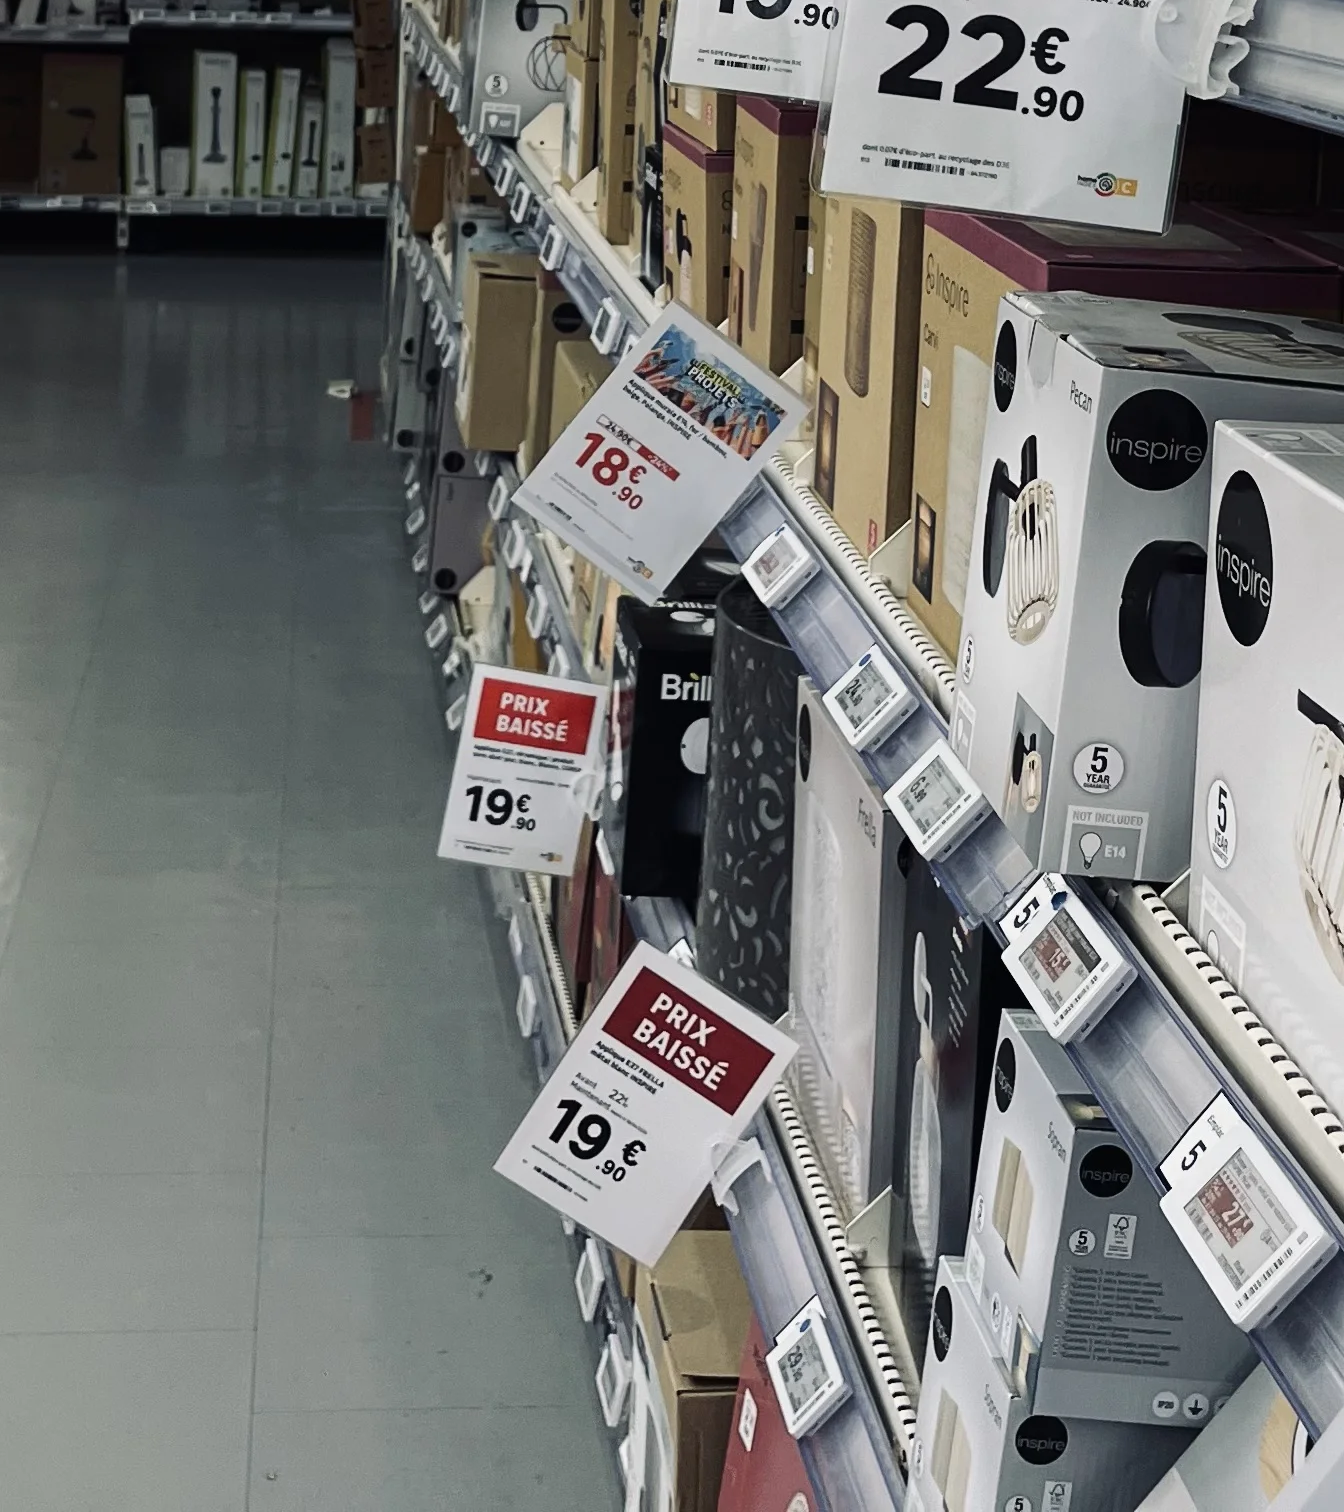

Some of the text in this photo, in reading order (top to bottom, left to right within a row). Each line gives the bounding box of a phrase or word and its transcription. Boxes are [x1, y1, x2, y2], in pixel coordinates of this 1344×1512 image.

[877, 3, 1027, 112] 22
[1029, 26, 1070, 75] €
[935, 258, 970, 318] Inspire
[688, 366, 737, 409] PROJETS
[575, 432, 630, 487] 18
[628, 465, 648, 485] €
[1110, 431, 1203, 464] inspire
[1216, 534, 1271, 608] inspire
[660, 672, 712, 701] Brill
[499, 691, 550, 716] PRIX
[495, 714, 569, 743] BAISSÉ
[1090, 746, 1109, 774] 5
[1085, 772, 1111, 785] YEAR
[465, 785, 514, 826] 19
[516, 794, 532, 813] €
[1072, 810, 1144, 827] NOT INCLUDED
[1216, 785, 1228, 833] 5
[1104, 844, 1127, 859] E14
[649, 992, 717, 1048] PRIX
[596, 1040, 626, 1063] Applique
[632, 1017, 730, 1091] BAISSÉ
[548, 1098, 612, 1161] 19
[622, 1139, 647, 1167] €
[1081, 1167, 1130, 1185] inspire
[1077, 1231, 1088, 1246] 5
[1016, 1435, 1066, 1453] inspire
[1013, 1497, 1024, 1512] 5
